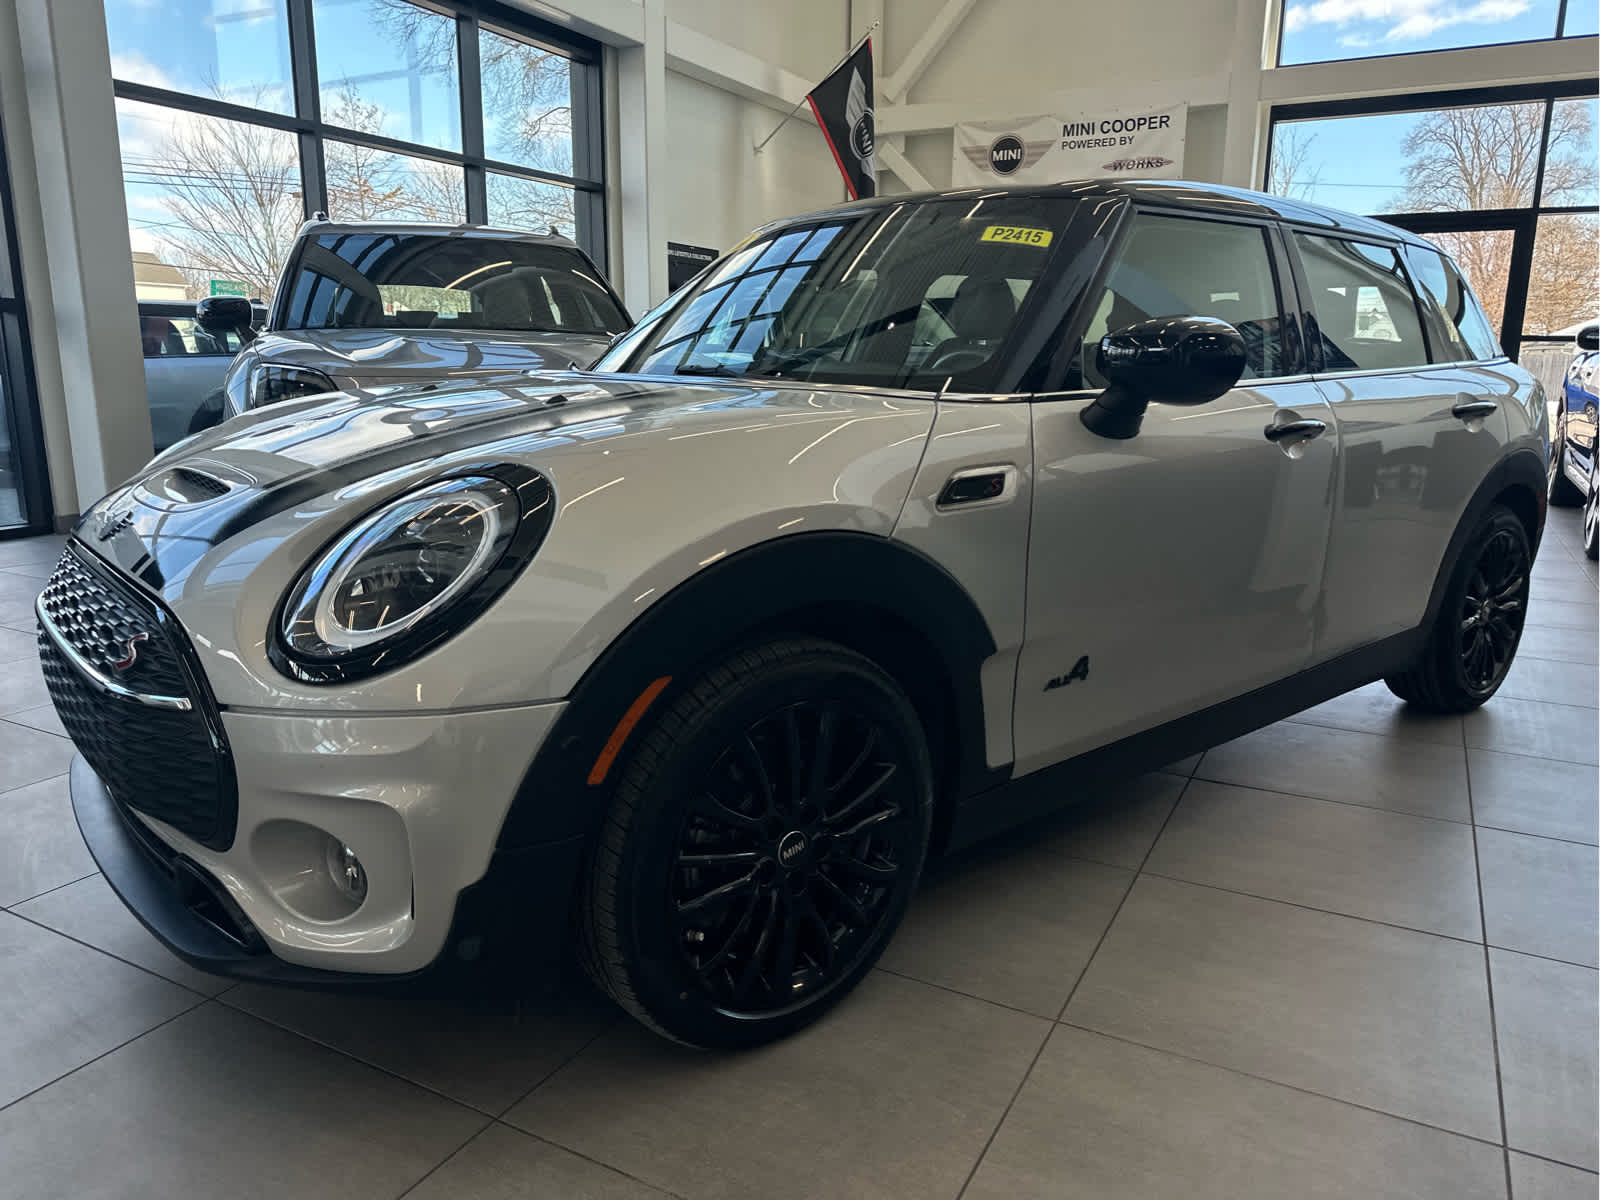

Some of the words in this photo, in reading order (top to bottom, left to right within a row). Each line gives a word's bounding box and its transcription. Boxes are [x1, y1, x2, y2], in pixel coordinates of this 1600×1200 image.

[1062, 121, 1096, 138] MINI
[1100, 115, 1170, 134] COOPER
[1061, 137, 1116, 150] POWERED
[1119, 135, 1135, 146] BY
[992, 148, 1021, 162] MINI
[1111, 157, 1164, 171] WORKS
[991, 228, 1043, 243] P2415
[783, 839, 806, 859] MINI
